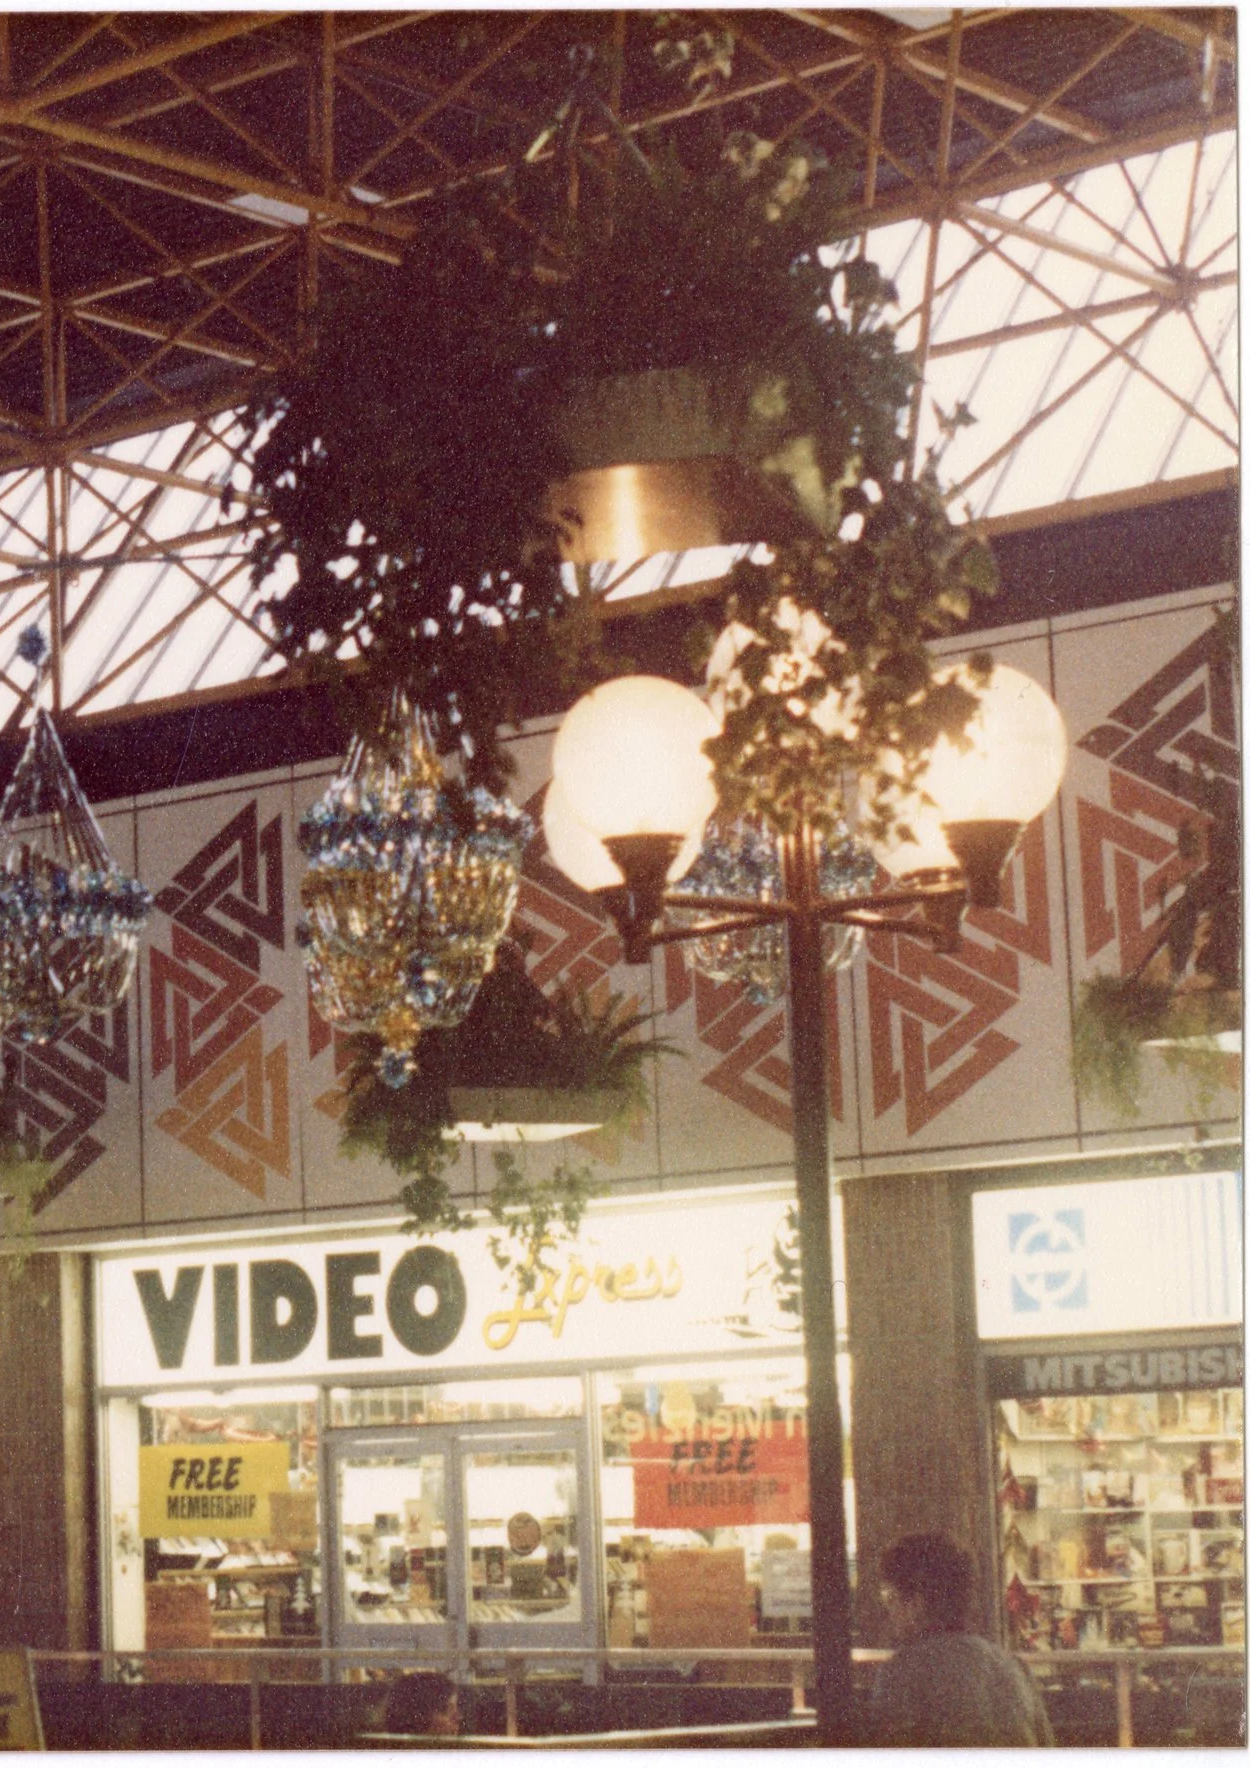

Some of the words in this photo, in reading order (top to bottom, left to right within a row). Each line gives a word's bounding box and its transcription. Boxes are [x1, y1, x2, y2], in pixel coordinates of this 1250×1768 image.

[132, 1244, 467, 1370] VIDEO
[169, 1456, 243, 1490] FREE
[669, 1437, 758, 1475] FREE
[166, 1494, 256, 1520] MEMBERSHIP
